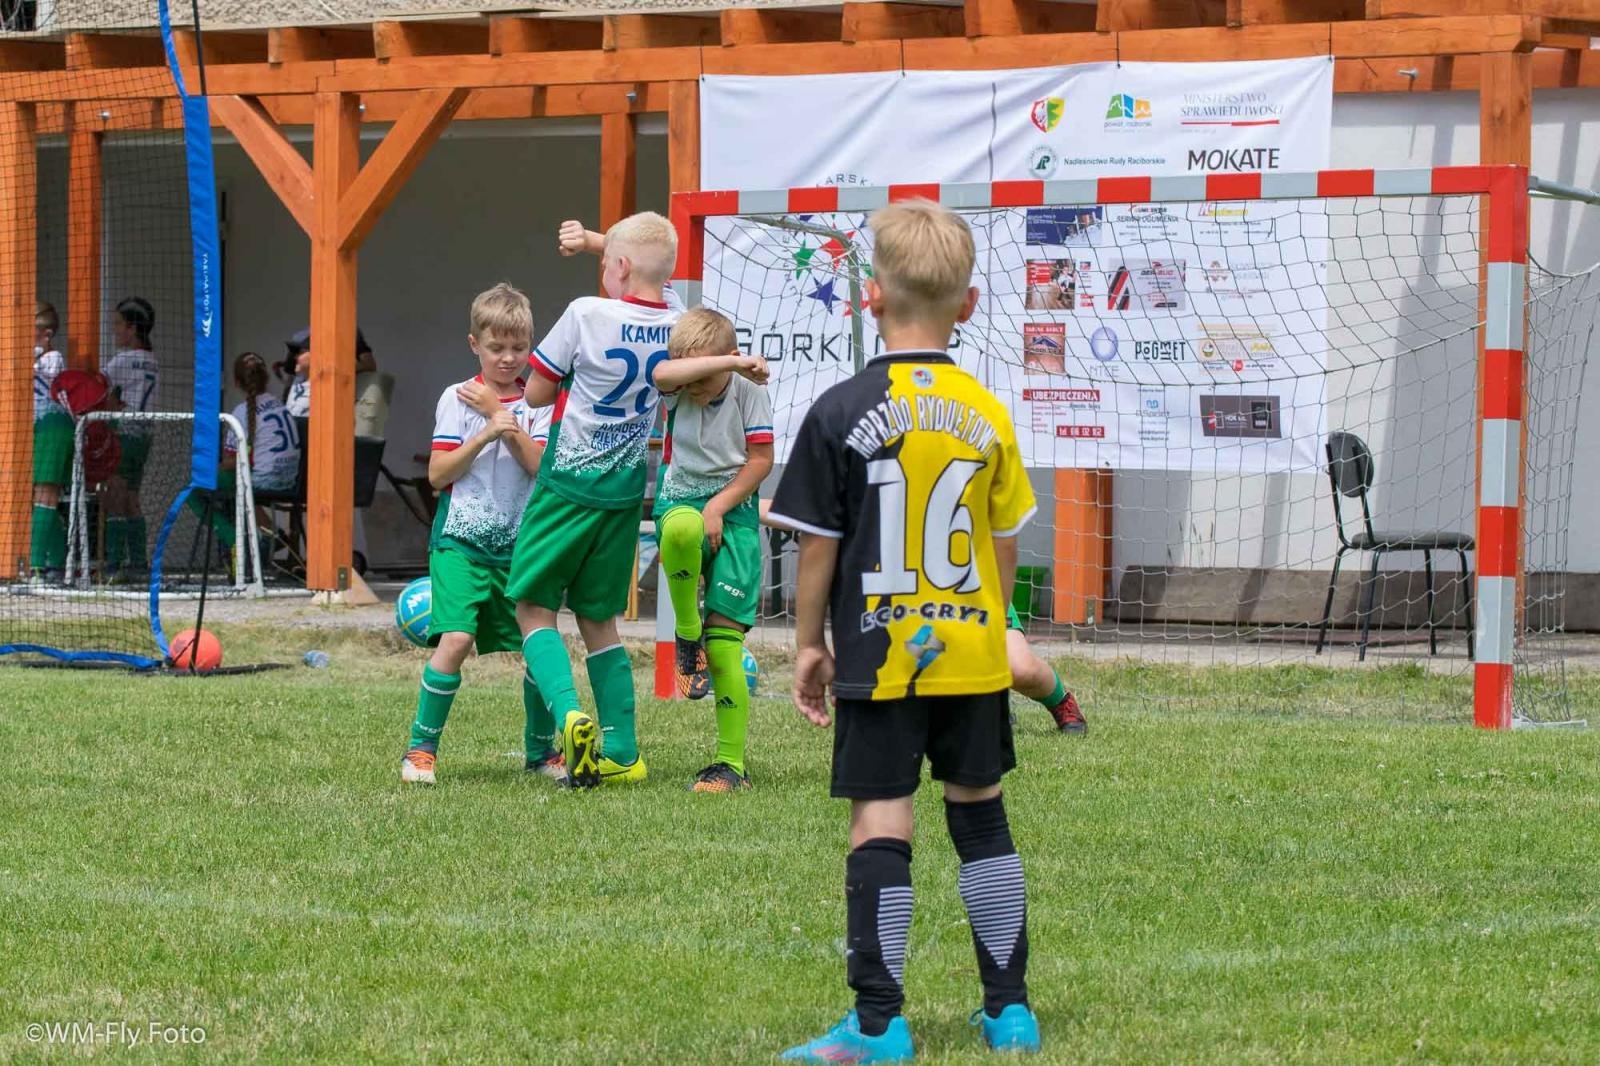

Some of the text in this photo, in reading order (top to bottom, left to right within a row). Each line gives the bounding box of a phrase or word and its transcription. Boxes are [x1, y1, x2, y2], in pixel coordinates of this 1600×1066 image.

[1109, 156, 1126, 167] Rudy
[1127, 156, 1166, 166] Raciborskie
[1188, 148, 1280, 171] MOKATE
[1032, 391, 1098, 401] UBEZPIECZENIA
[862, 458, 988, 595] 16
